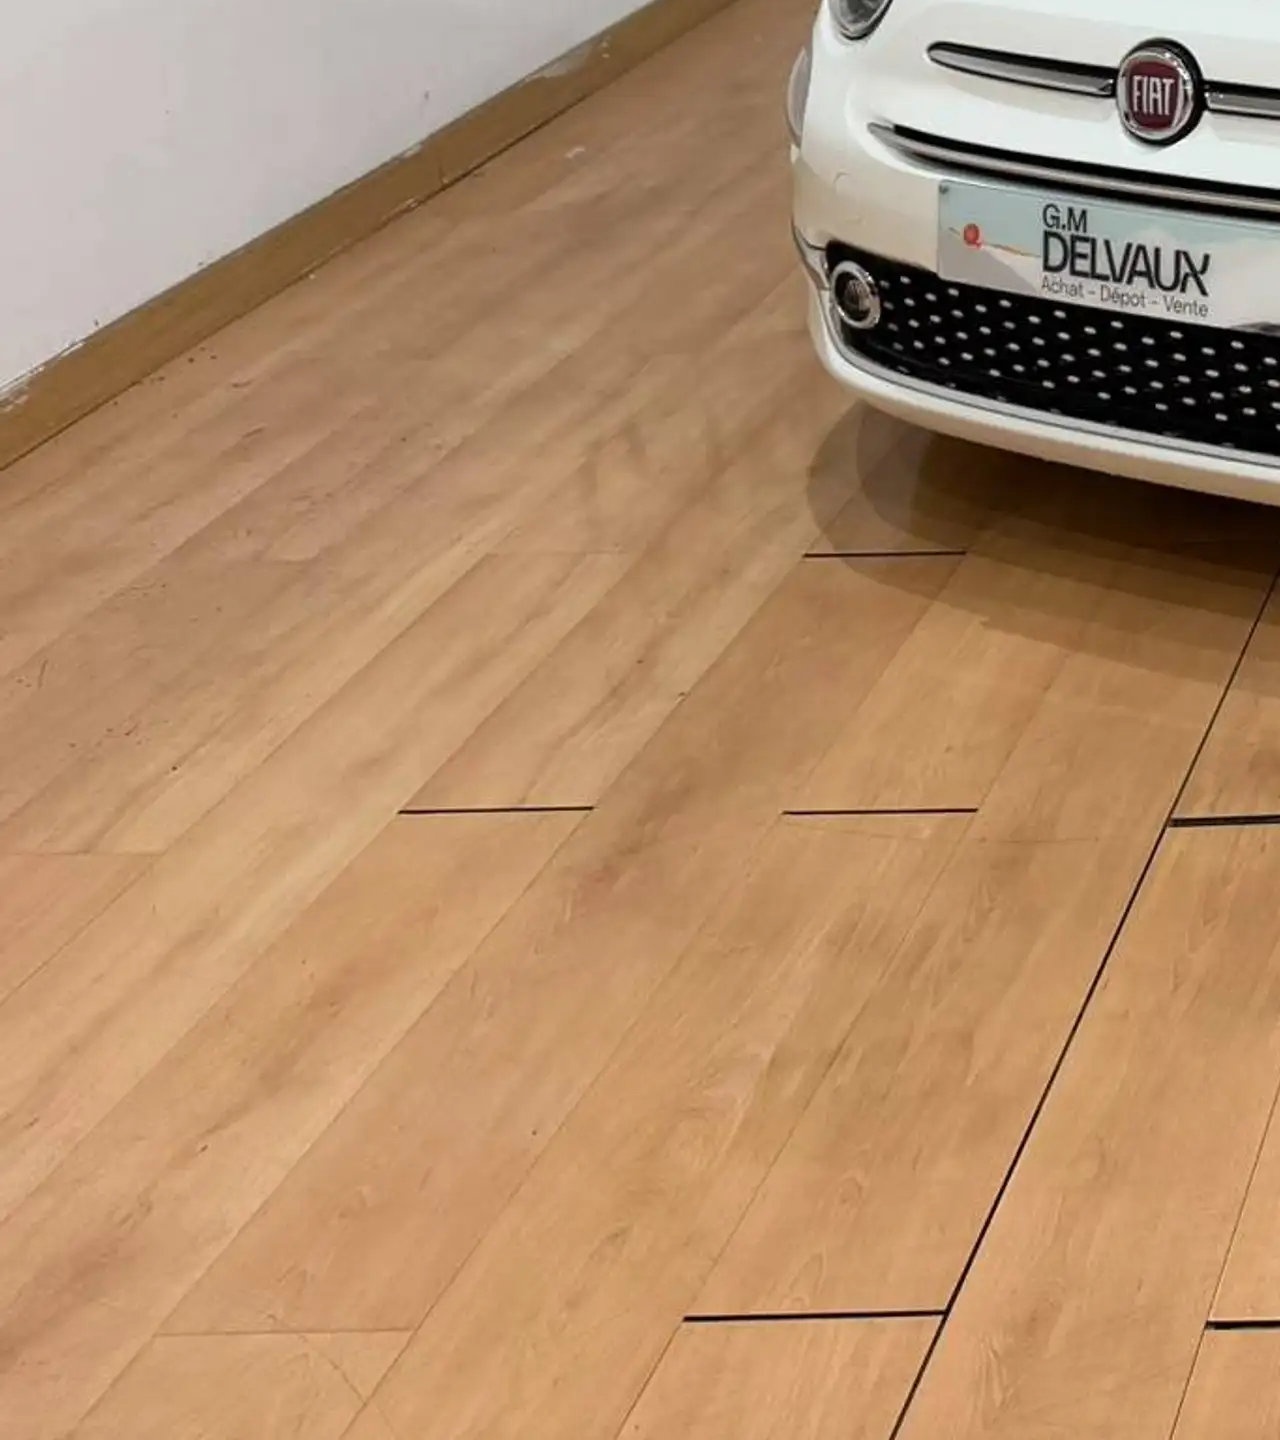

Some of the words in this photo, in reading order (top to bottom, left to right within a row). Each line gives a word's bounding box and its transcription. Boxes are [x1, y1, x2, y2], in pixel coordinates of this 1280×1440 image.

[1132, 75, 1175, 116] FIAT
[1042, 203, 1088, 233] G.M
[1042, 230, 1211, 297] DELVAUX
[1041, 276, 1084, 299] Achat
[1100, 284, 1146, 309] Dépot
[1163, 295, 1209, 317] Vente
